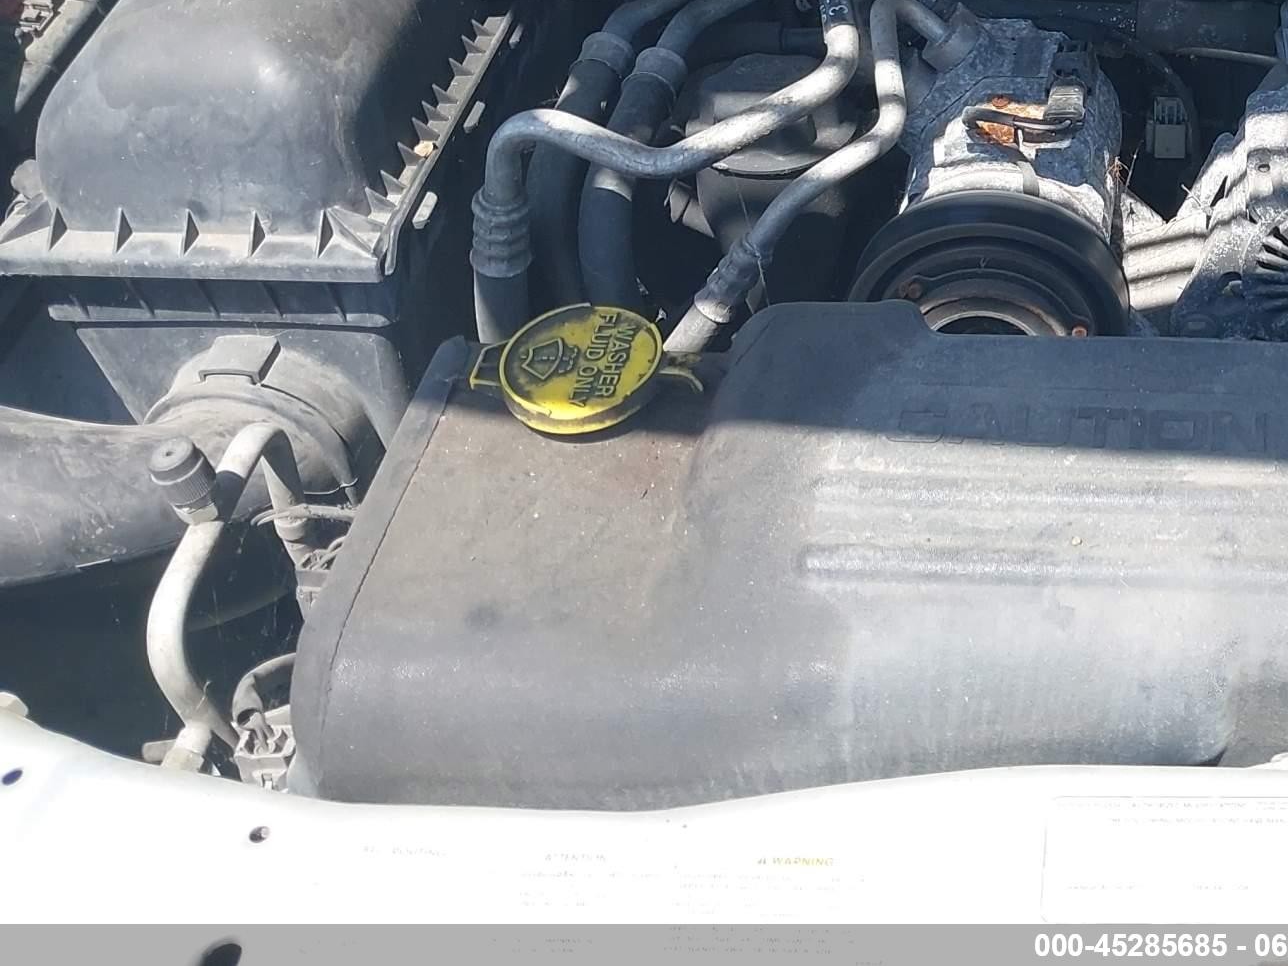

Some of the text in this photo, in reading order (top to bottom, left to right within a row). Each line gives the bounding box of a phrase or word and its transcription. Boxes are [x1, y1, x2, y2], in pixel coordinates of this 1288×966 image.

[569, 313, 617, 409] FLUID ONLY
[596, 322, 635, 398] WASHER
[887, 404, 1270, 453] CAUTION
